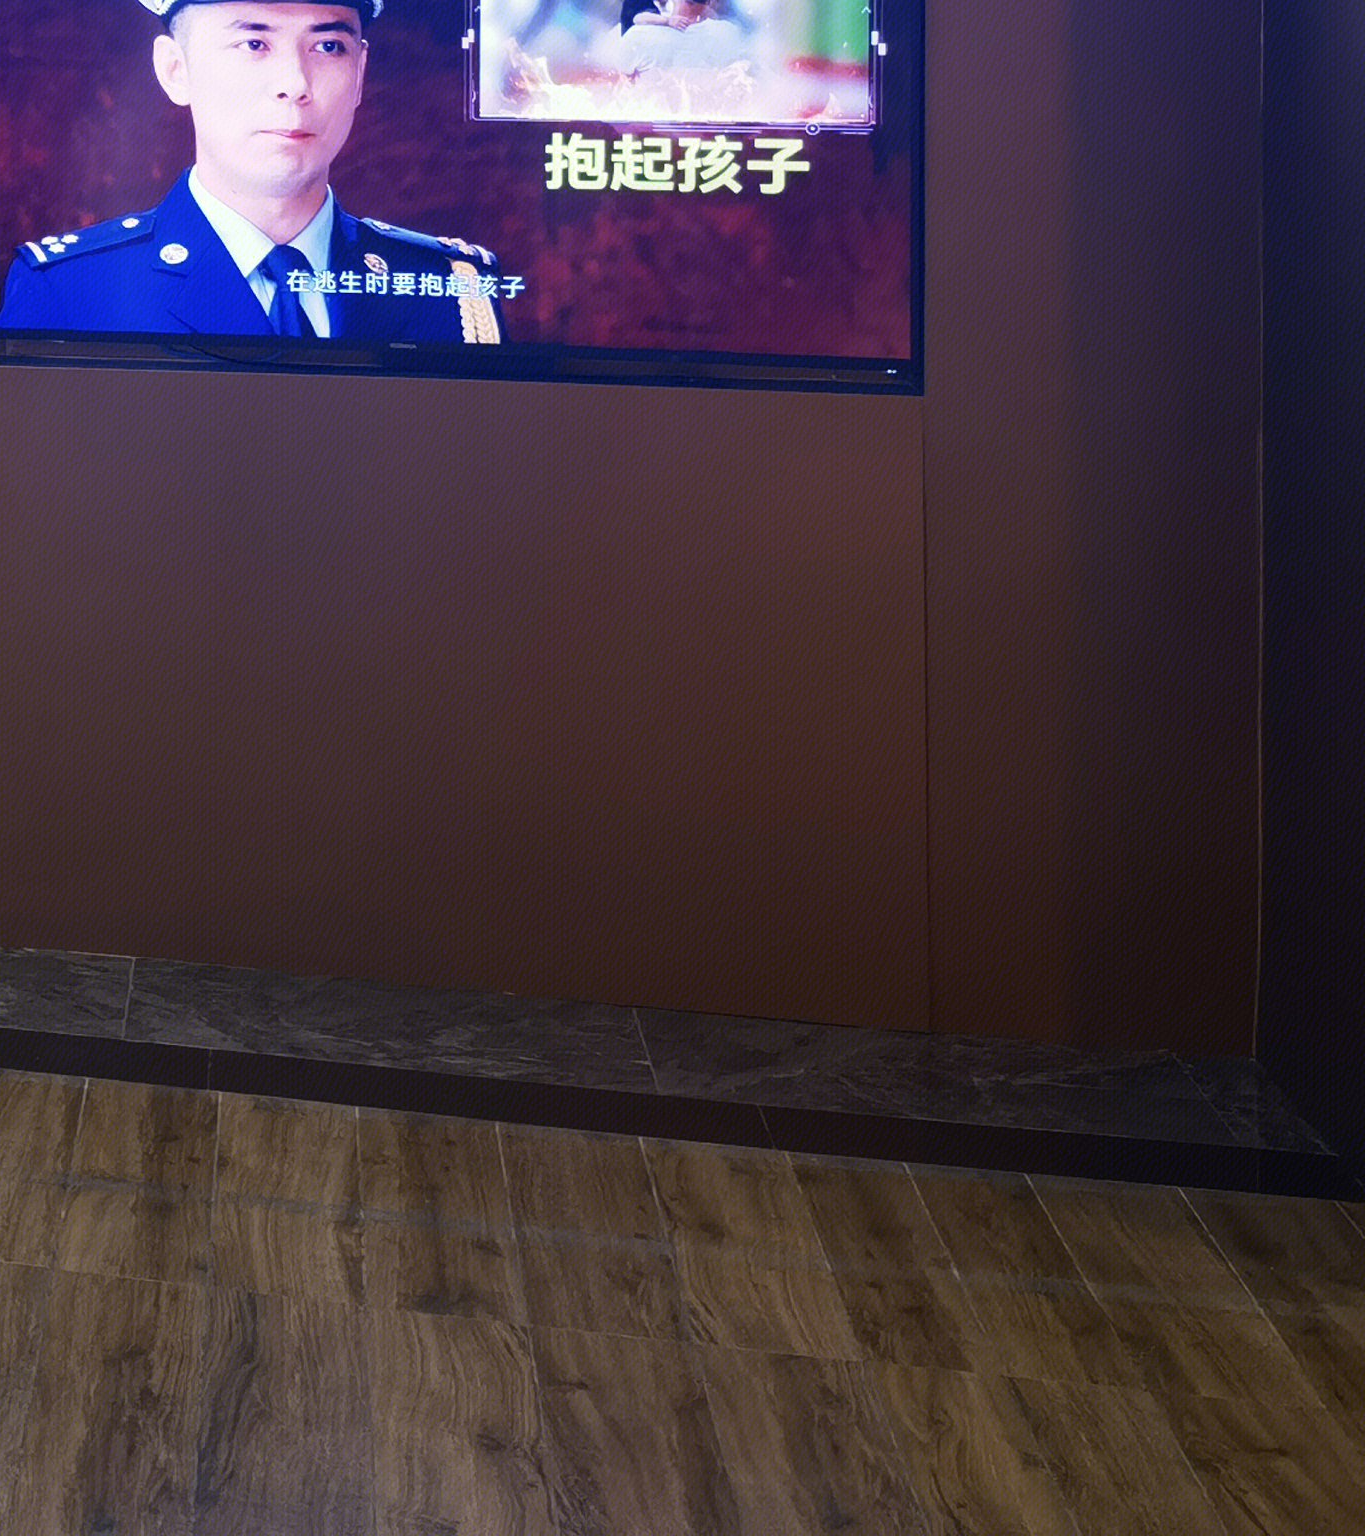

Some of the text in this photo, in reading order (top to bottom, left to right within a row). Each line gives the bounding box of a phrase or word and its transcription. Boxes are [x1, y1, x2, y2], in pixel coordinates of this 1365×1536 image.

[543, 131, 812, 196] 抱起孩子
[285, 268, 526, 300] 在逃生时要抱起孩子
